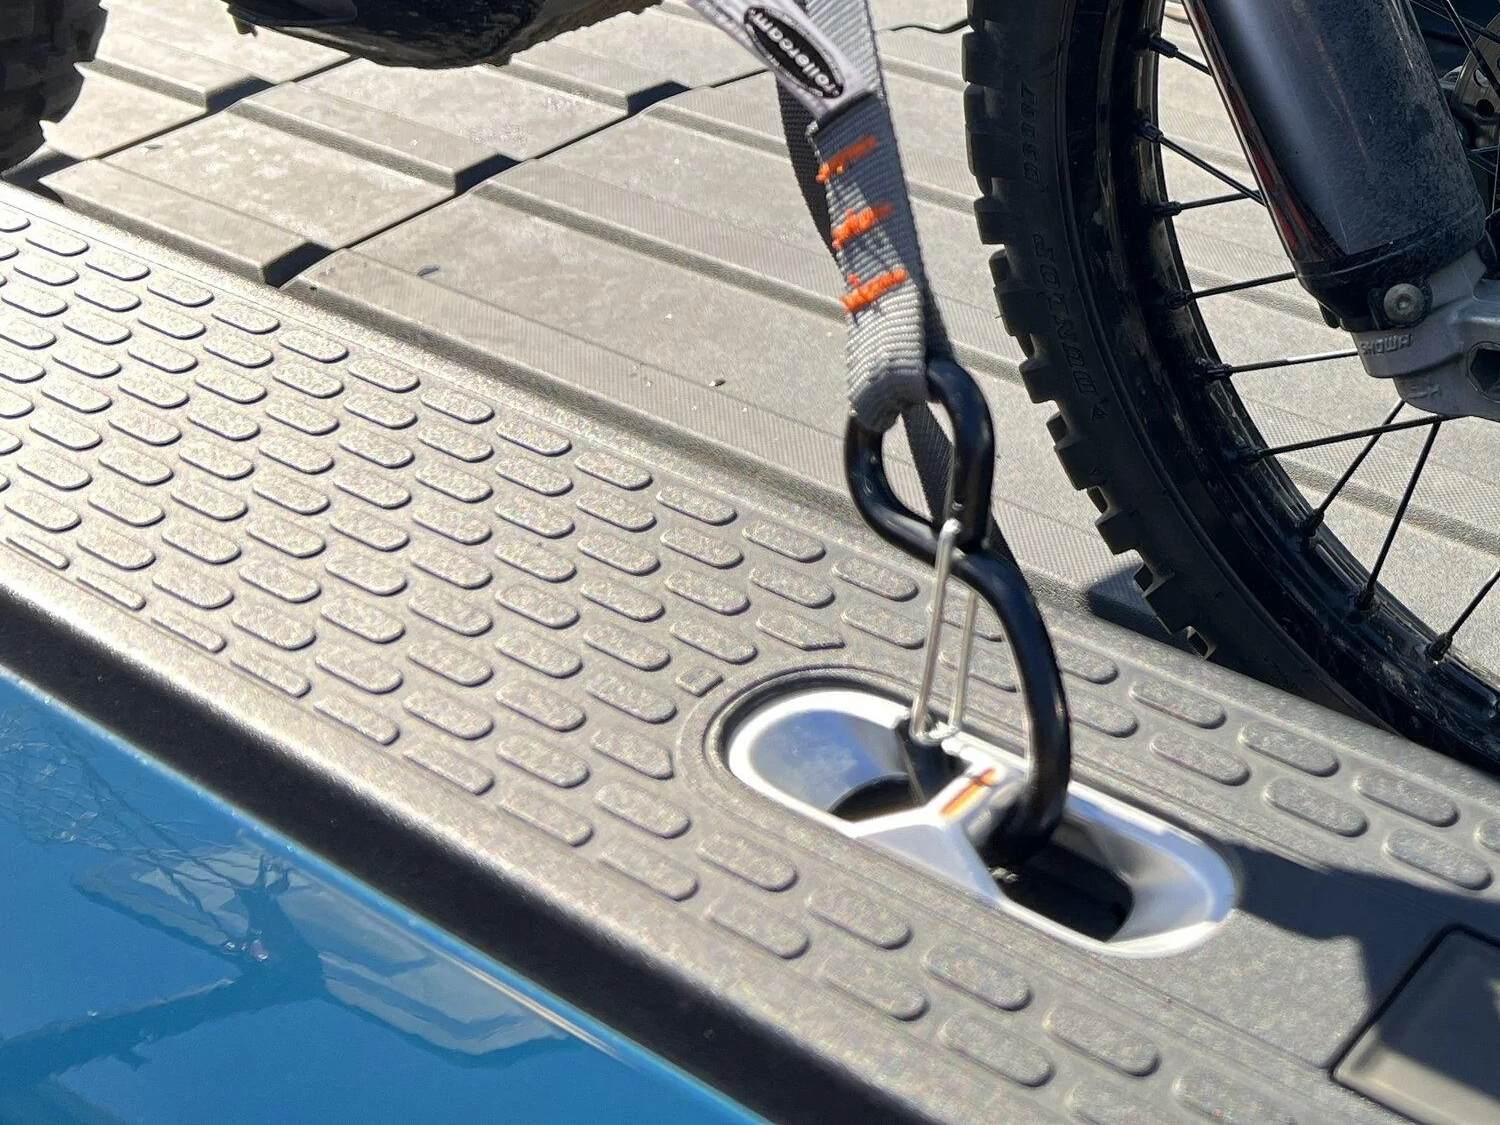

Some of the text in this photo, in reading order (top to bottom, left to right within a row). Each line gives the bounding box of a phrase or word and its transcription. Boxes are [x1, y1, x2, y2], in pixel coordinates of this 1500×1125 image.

[752, 11, 836, 93] rollercam
[1032, 233, 1099, 396] DUNLOP
[1360, 332, 1412, 355] SHOWA
